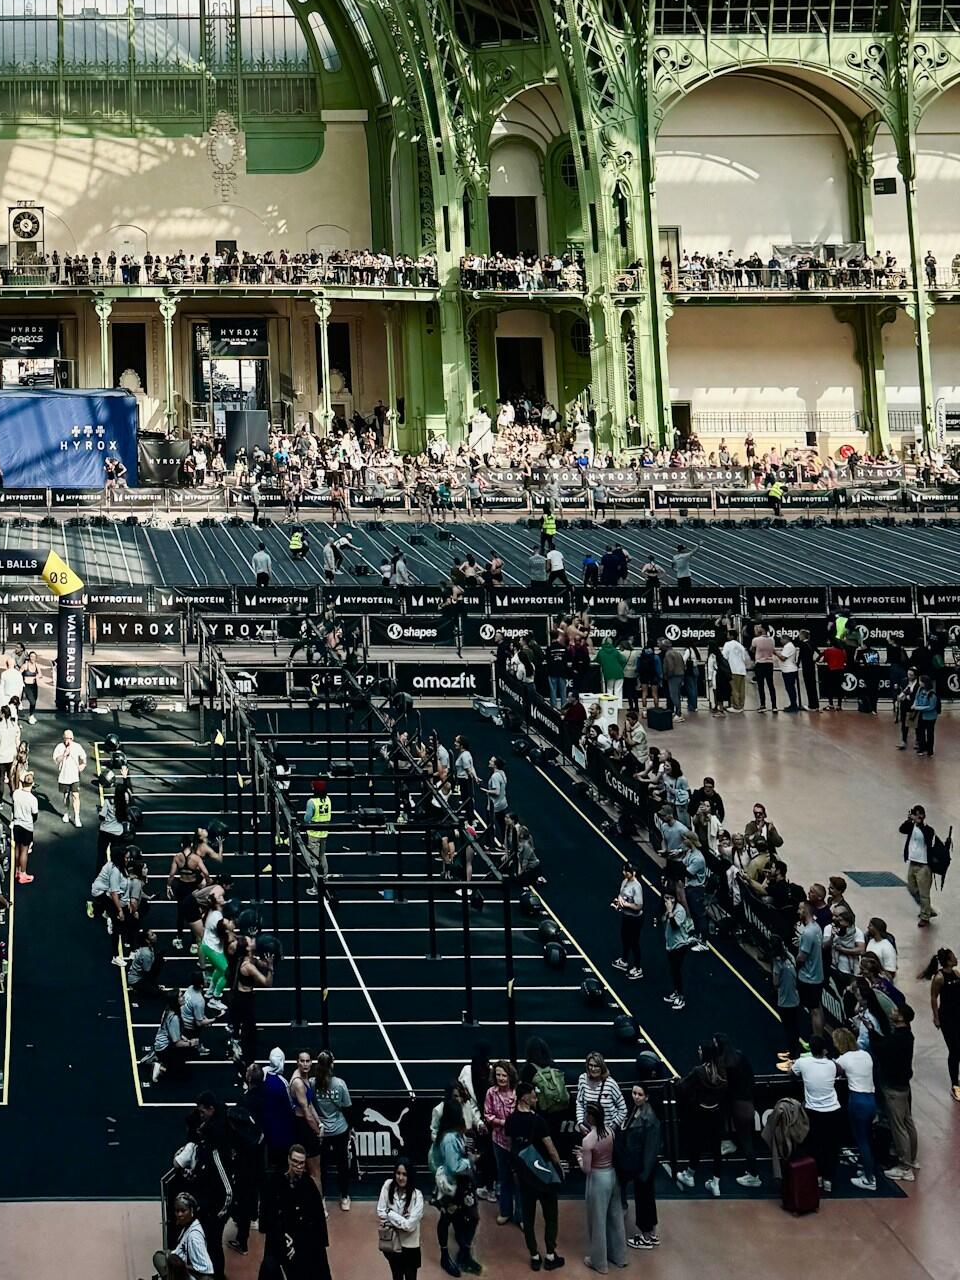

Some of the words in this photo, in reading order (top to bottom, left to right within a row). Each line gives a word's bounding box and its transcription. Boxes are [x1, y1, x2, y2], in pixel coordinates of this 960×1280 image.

[220, 328, 259, 336] HYROX
[60, 441, 118, 451] HYROX
[588, 472, 633, 480] HYROX
[643, 472, 688, 480] HYROX
[697, 471, 742, 479] HYROX
[858, 470, 902, 478] HYROX
[922, 494, 959, 502] MYPROTEIN
[6, 559, 38, 569] BALLS
[49, 571, 68, 585] 08
[91, 595, 143, 603] MYPROTEIN
[175, 596, 225, 604] MYPROTEIN
[259, 596, 309, 604] MYPROTEIN
[343, 596, 393, 605] MYPROTEIN
[511, 596, 564, 605] MYPROTEIN
[682, 596, 733, 605] MYPROTEIN
[768, 596, 819, 605] MYPROTEIN
[853, 596, 906, 604] MYPROTEIN
[67, 614, 76, 645] WALL
[102, 623, 174, 635] HYROX
[403, 627, 437, 637] shapes
[681, 627, 716, 638] shapes
[870, 627, 905, 638] shapes
[66, 647, 76, 683] BALLS
[114, 676, 178, 686] MYPROTEIN
[412, 672, 477, 688] amazfit
[355, 1132, 391, 1157] MA
